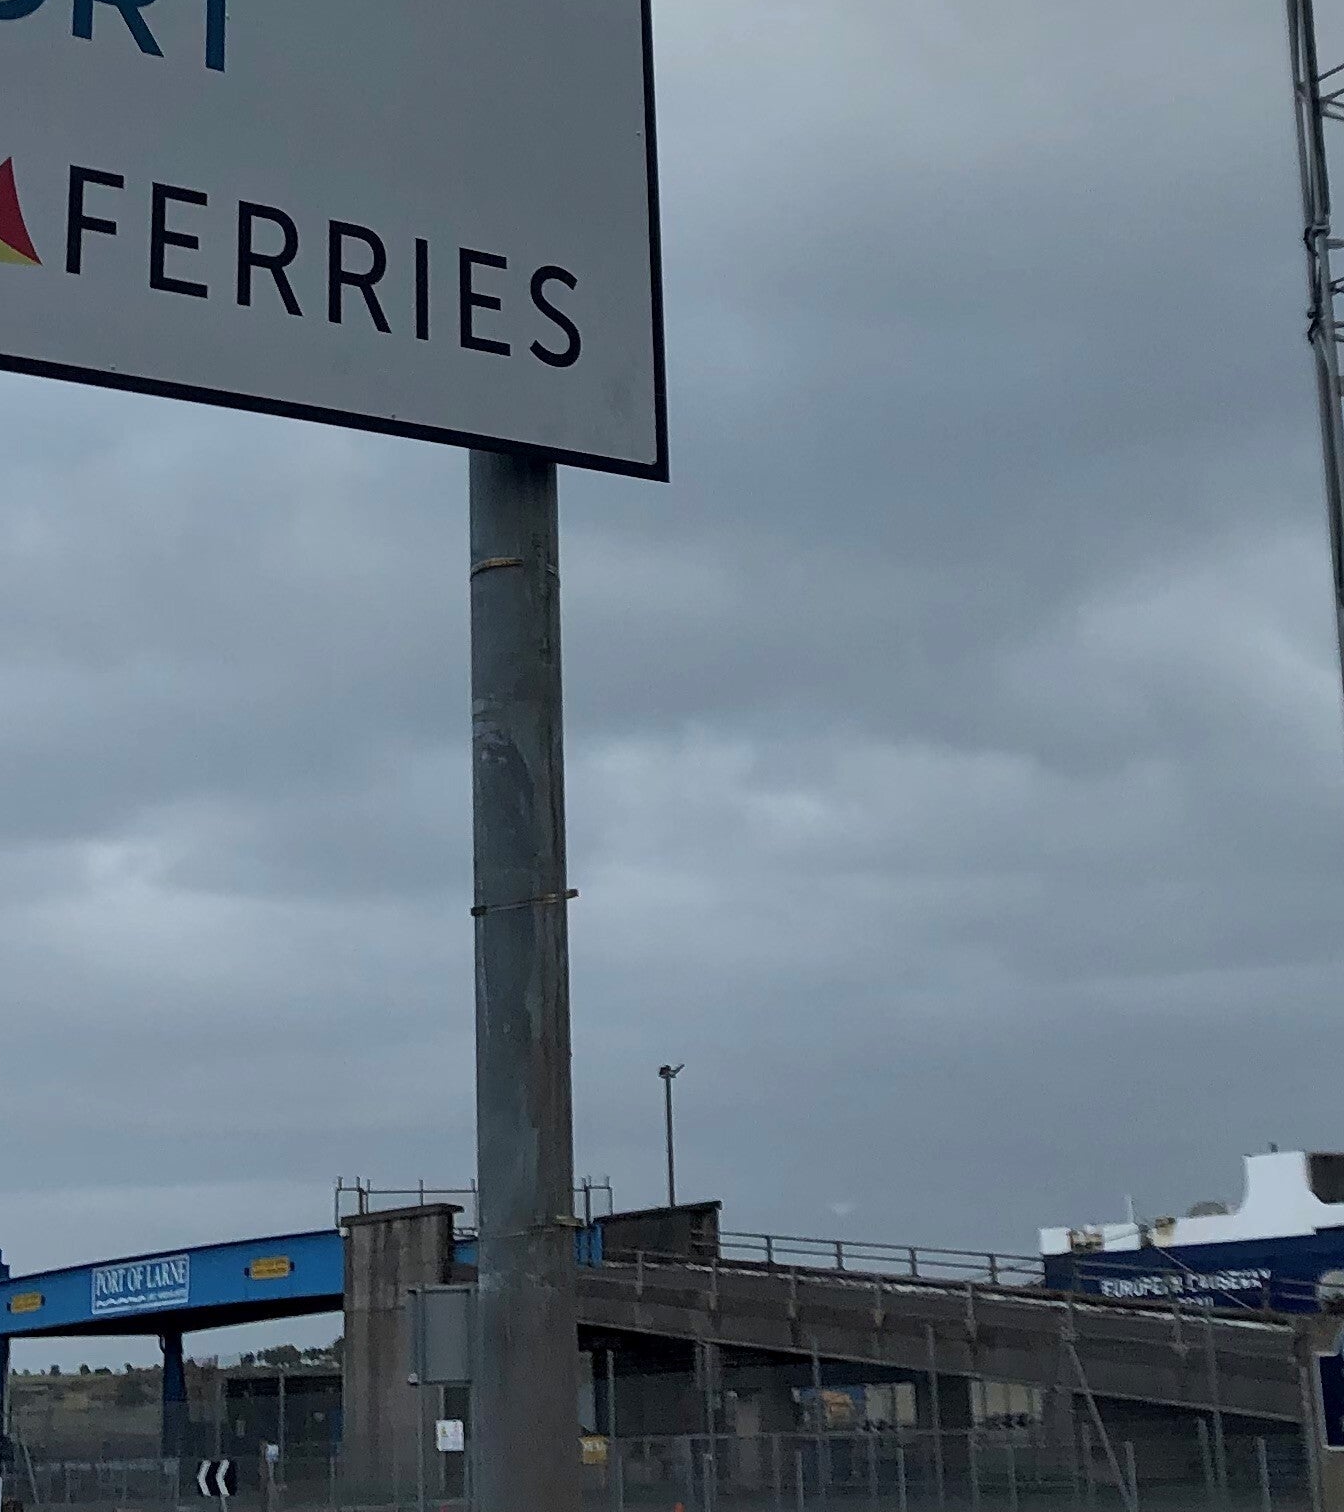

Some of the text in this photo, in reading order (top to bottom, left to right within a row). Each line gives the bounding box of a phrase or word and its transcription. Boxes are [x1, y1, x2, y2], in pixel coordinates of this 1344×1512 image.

[65, 165, 584, 369] FERRIES
[96, 1268, 125, 1296] PORT
[127, 1266, 143, 1293] OF
[146, 1259, 186, 1288] LARNE
